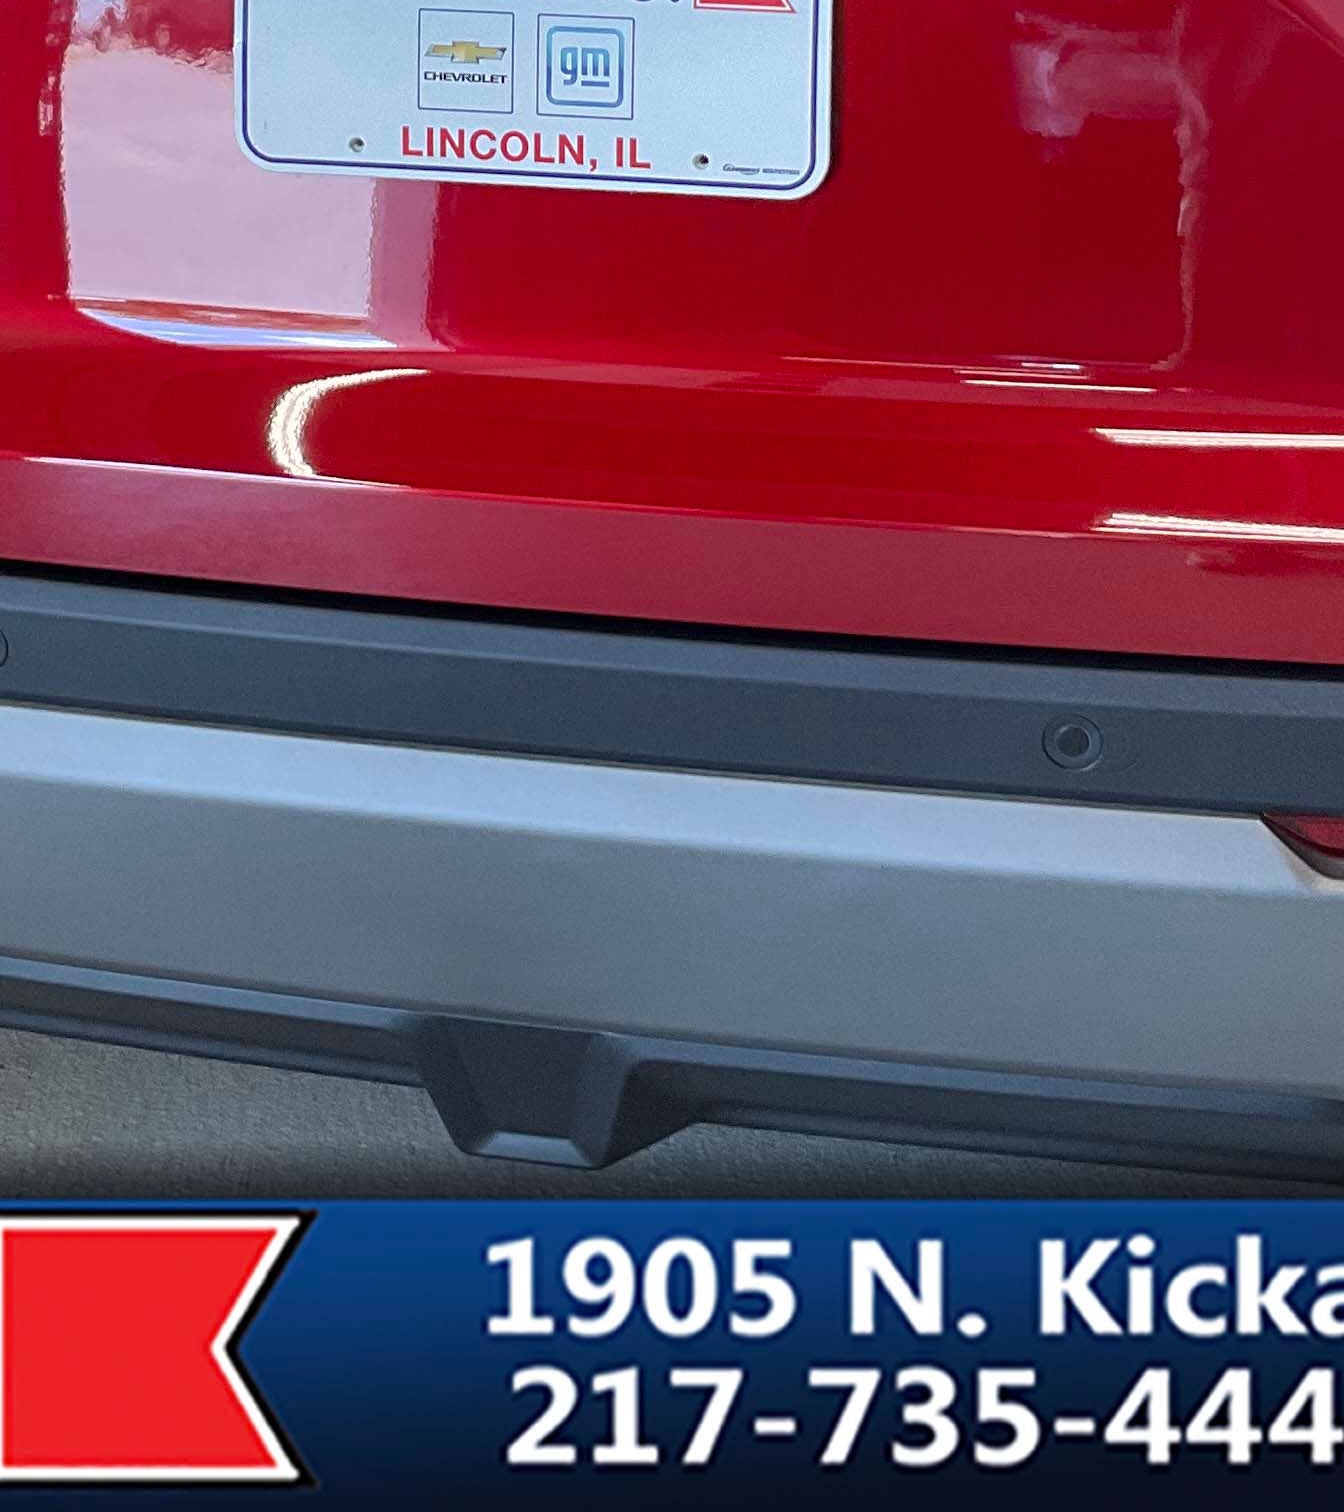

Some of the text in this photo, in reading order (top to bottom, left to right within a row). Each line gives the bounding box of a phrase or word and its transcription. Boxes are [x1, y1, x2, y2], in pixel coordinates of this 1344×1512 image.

[423, 70, 508, 85] CHEVROLET
[559, 46, 611, 86] gm
[400, 125, 652, 173] LINCOLN, IL
